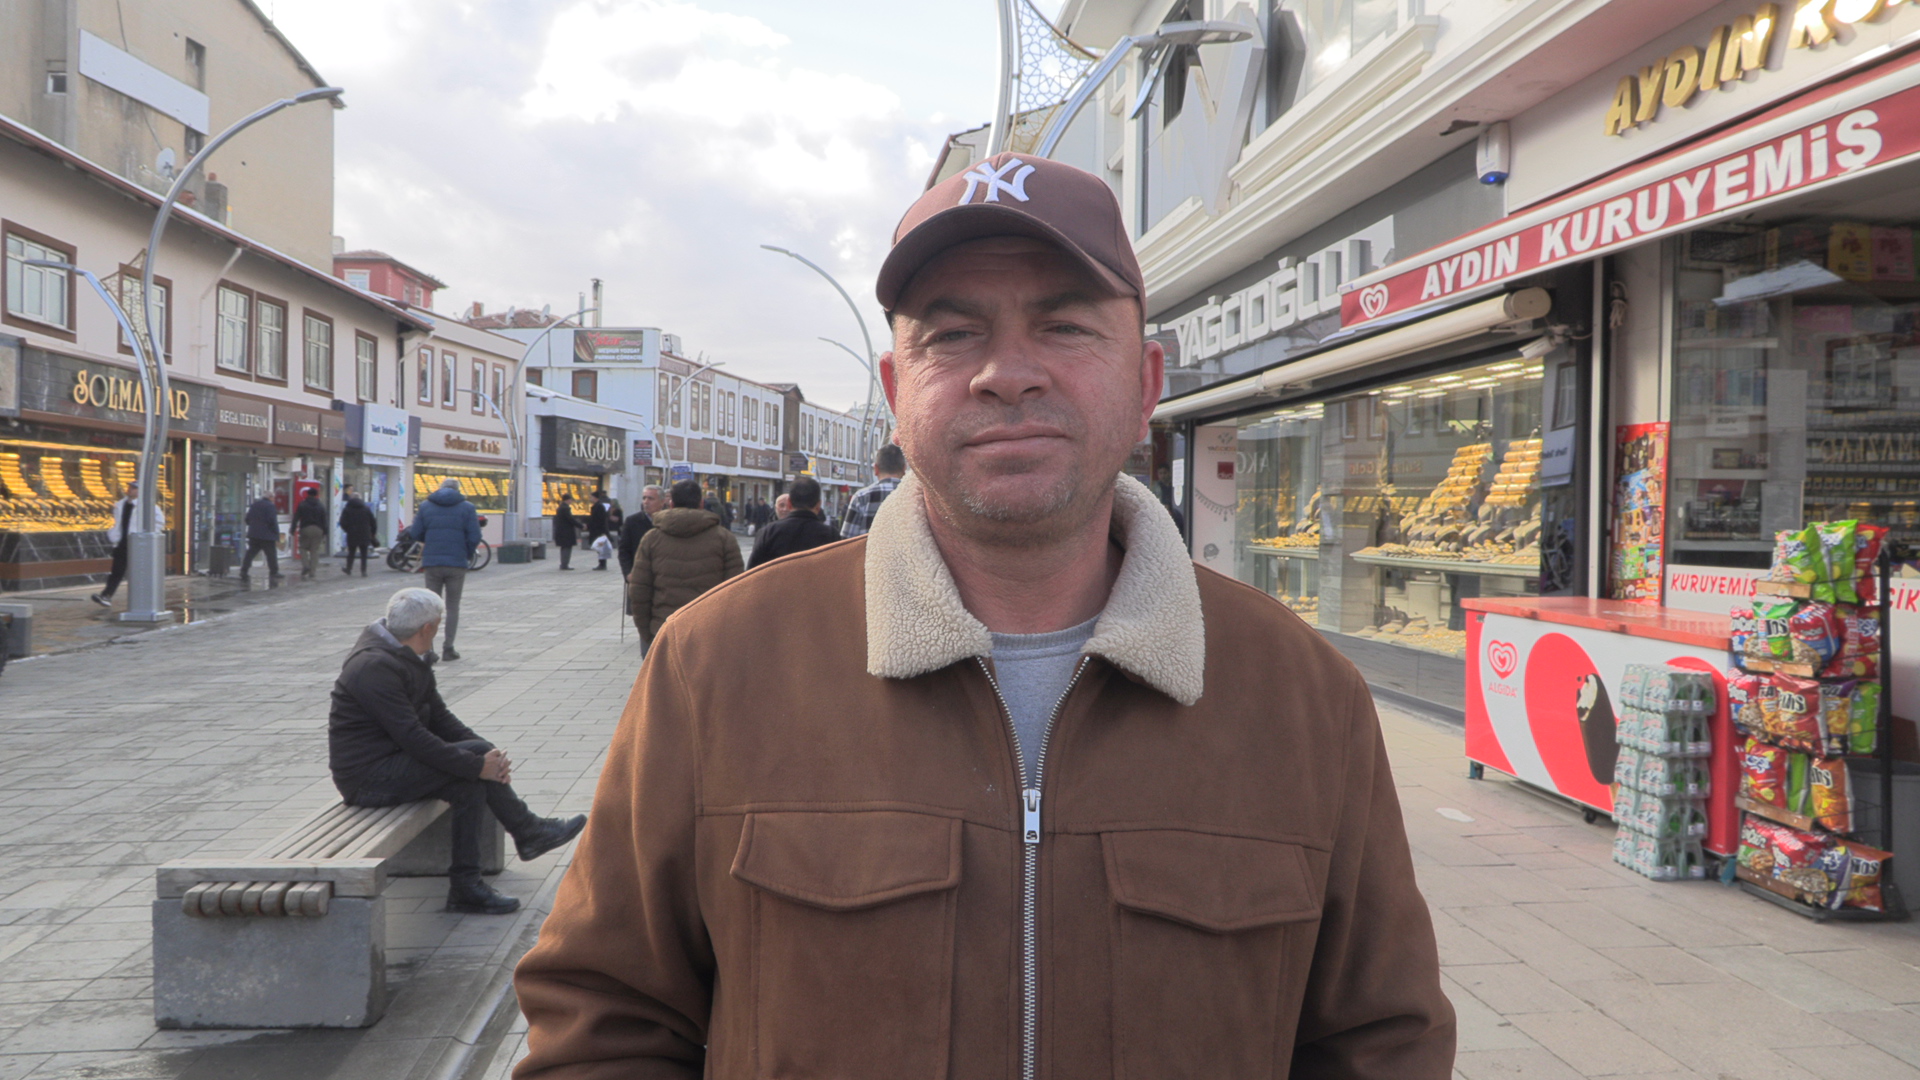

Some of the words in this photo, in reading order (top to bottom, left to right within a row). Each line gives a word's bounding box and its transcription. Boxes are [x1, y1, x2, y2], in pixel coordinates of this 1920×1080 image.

[1604, 3, 1778, 136] AYDIN
[1421, 234, 1520, 300] AYDIN
[569, 433, 620, 461] AKGOLD
